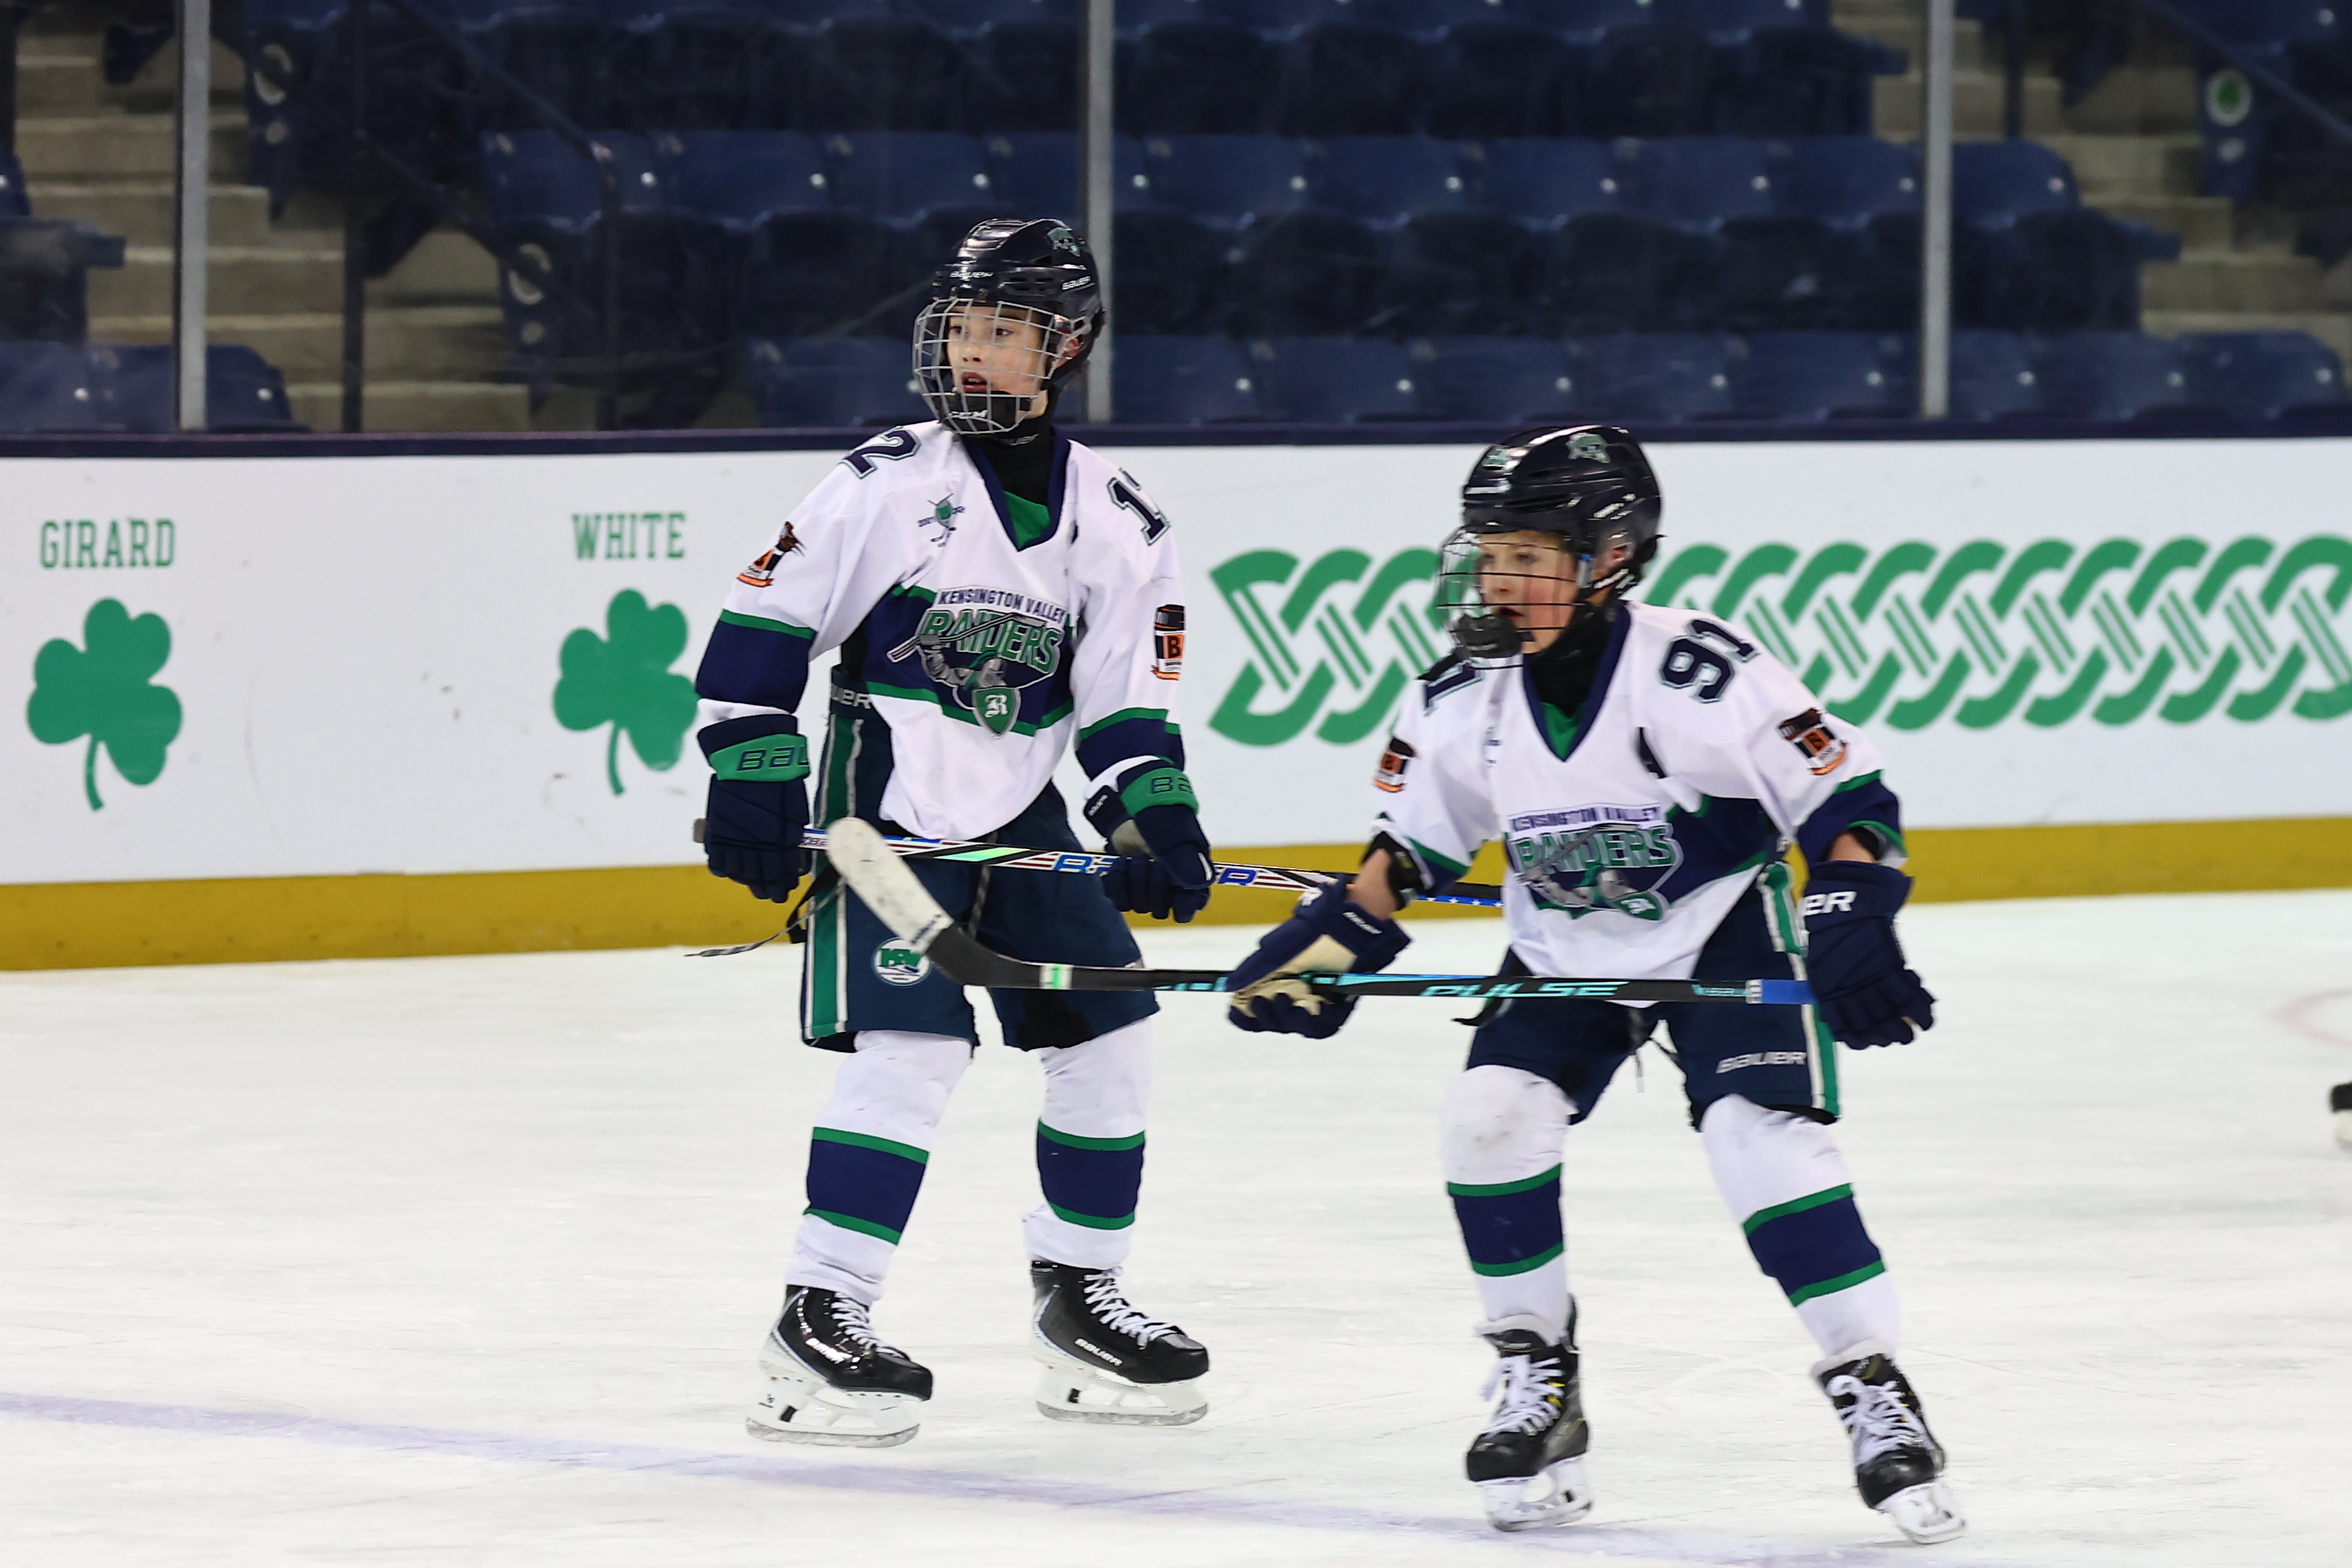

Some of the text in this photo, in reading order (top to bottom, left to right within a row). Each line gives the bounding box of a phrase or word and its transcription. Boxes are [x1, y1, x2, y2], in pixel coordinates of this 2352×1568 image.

[40, 520, 175, 569] GIRARD
[571, 513, 685, 559] WHITE
[938, 589, 1025, 611] KENSINGTON
[917, 609, 1065, 674] RAIDERS
[1659, 618, 1761, 704] 91
[1513, 825, 1674, 873] RAIDERS
[1418, 982, 1630, 998] PULSE
[1716, 1051, 1807, 1074] BAUER
[1074, 1338, 1123, 1366] BAUER
